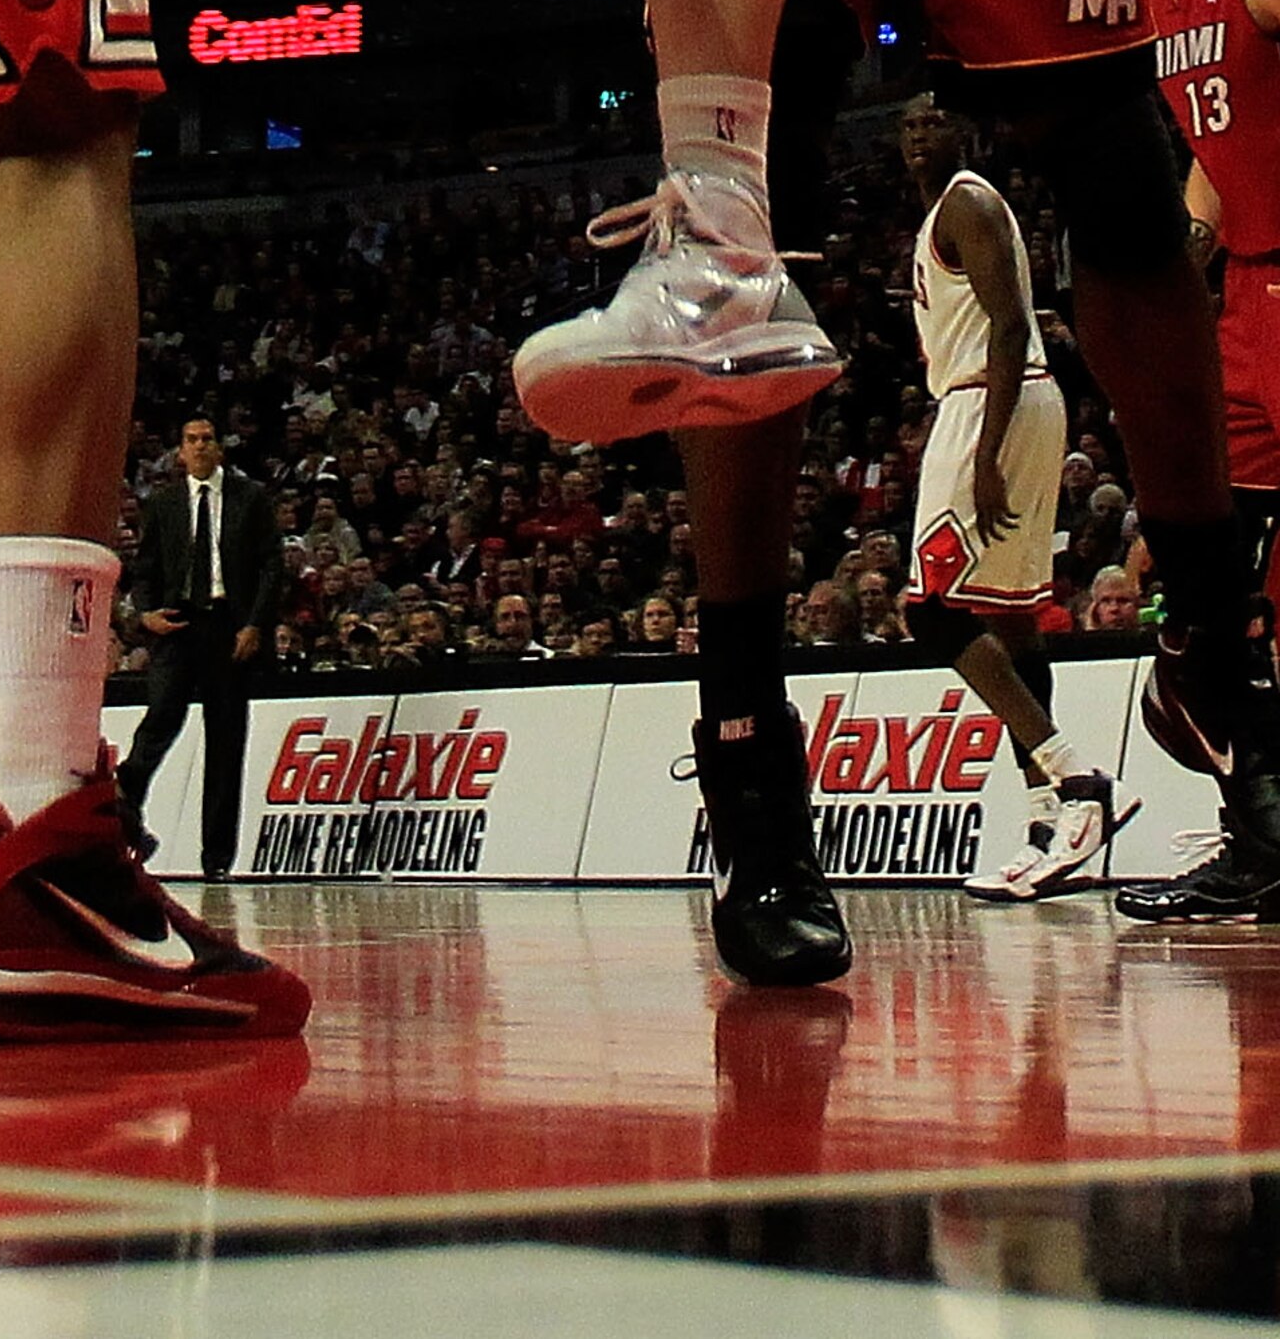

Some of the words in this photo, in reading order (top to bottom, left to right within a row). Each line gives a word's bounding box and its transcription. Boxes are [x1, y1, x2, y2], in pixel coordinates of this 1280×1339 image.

[189, 3, 363, 64] ComEd
[1185, 76, 1231, 137] 13
[266, 707, 508, 805] Galaxie
[251, 813, 326, 873] HOME
[322, 808, 489, 873] REMODELING
